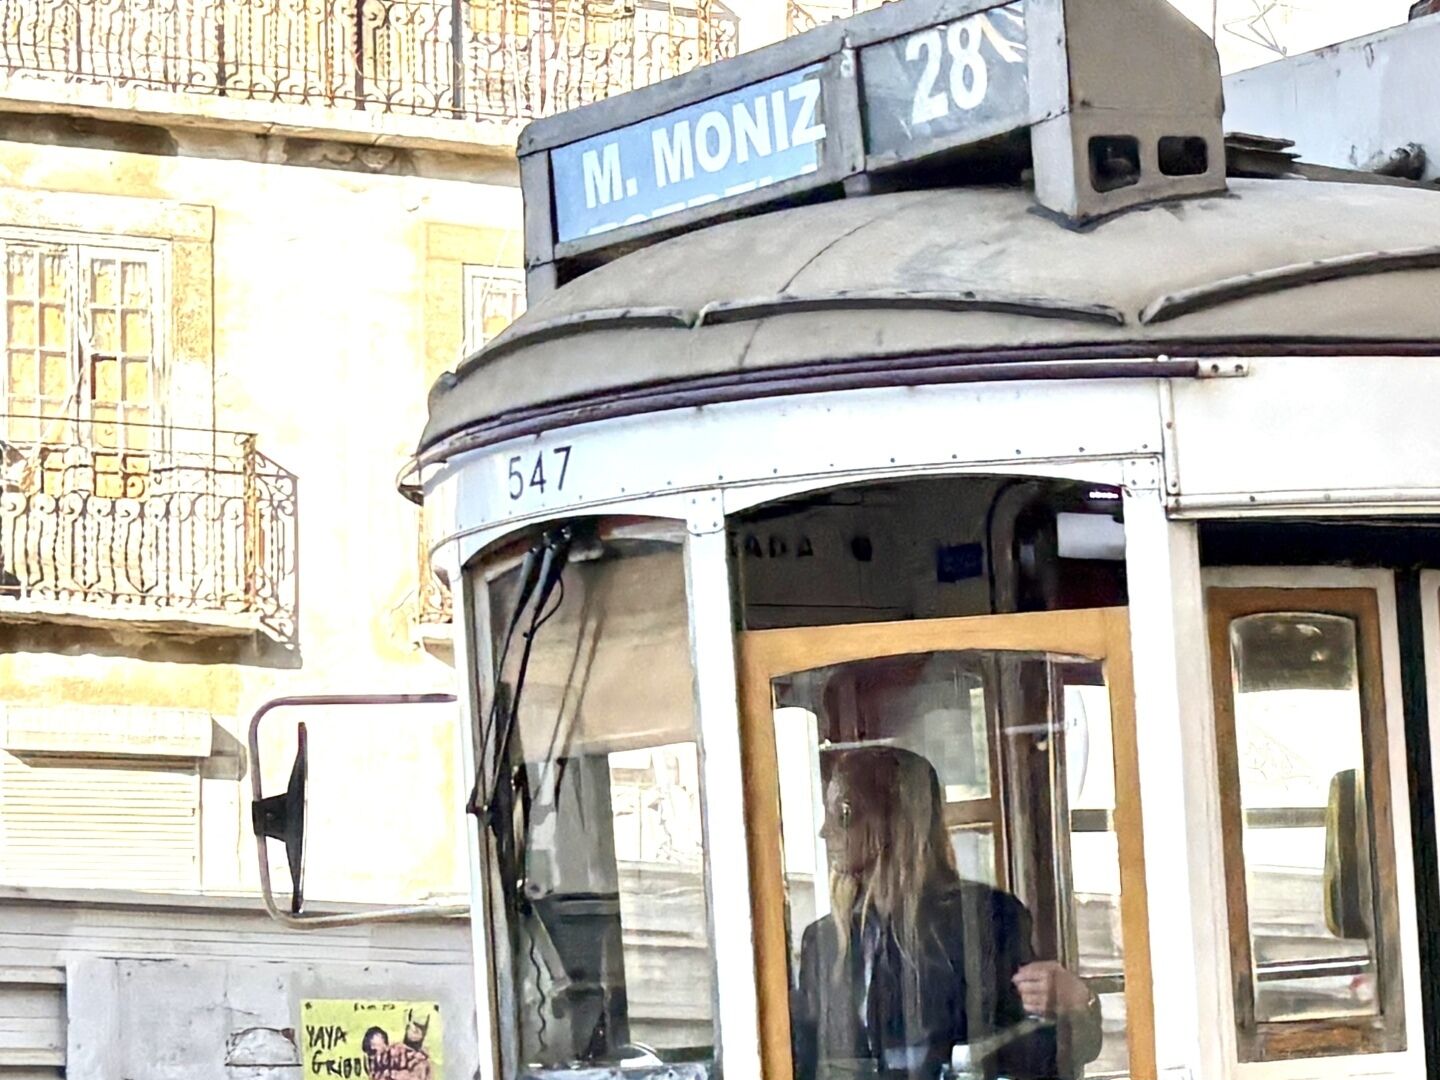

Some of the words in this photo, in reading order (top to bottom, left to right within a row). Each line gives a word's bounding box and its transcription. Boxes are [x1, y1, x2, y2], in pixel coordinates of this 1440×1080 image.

[905, 14, 987, 125] 28
[582, 143, 638, 209] M.
[651, 78, 826, 188] MONIZ
[509, 445, 572, 500] 547
